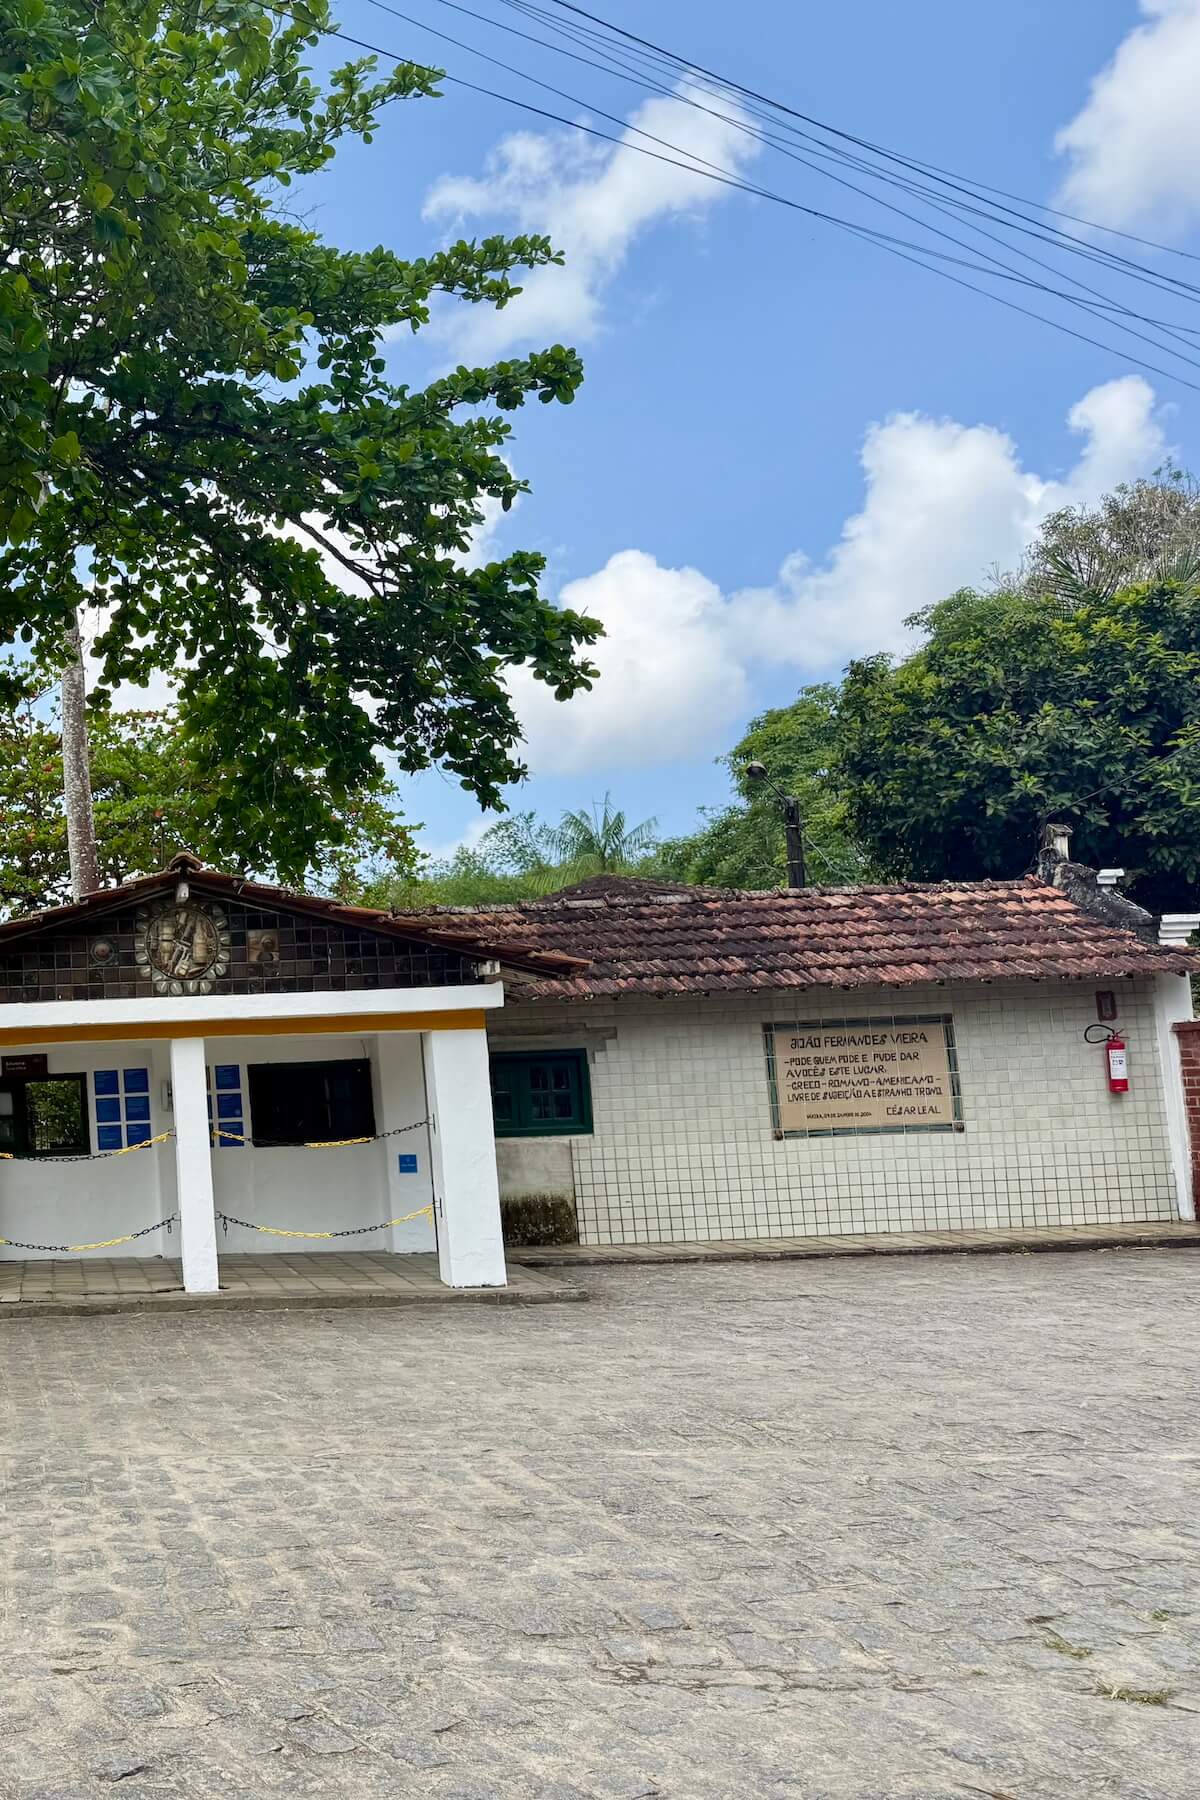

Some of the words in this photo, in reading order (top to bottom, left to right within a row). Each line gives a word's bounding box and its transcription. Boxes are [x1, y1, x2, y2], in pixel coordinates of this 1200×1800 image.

[790, 1035, 821, 1049] JOÃO
[824, 1034, 887, 1048] FERNANDES
[813, 1055, 838, 1065] QUEM
[839, 1054, 860, 1064] PODE
[862, 1054, 869, 1062] E
[900, 1051, 920, 1061] DAR
[829, 1066, 850, 1076] ESTE
[915, 1087, 942, 1096] TRONO
[917, 1105, 941, 1115] LEAL
